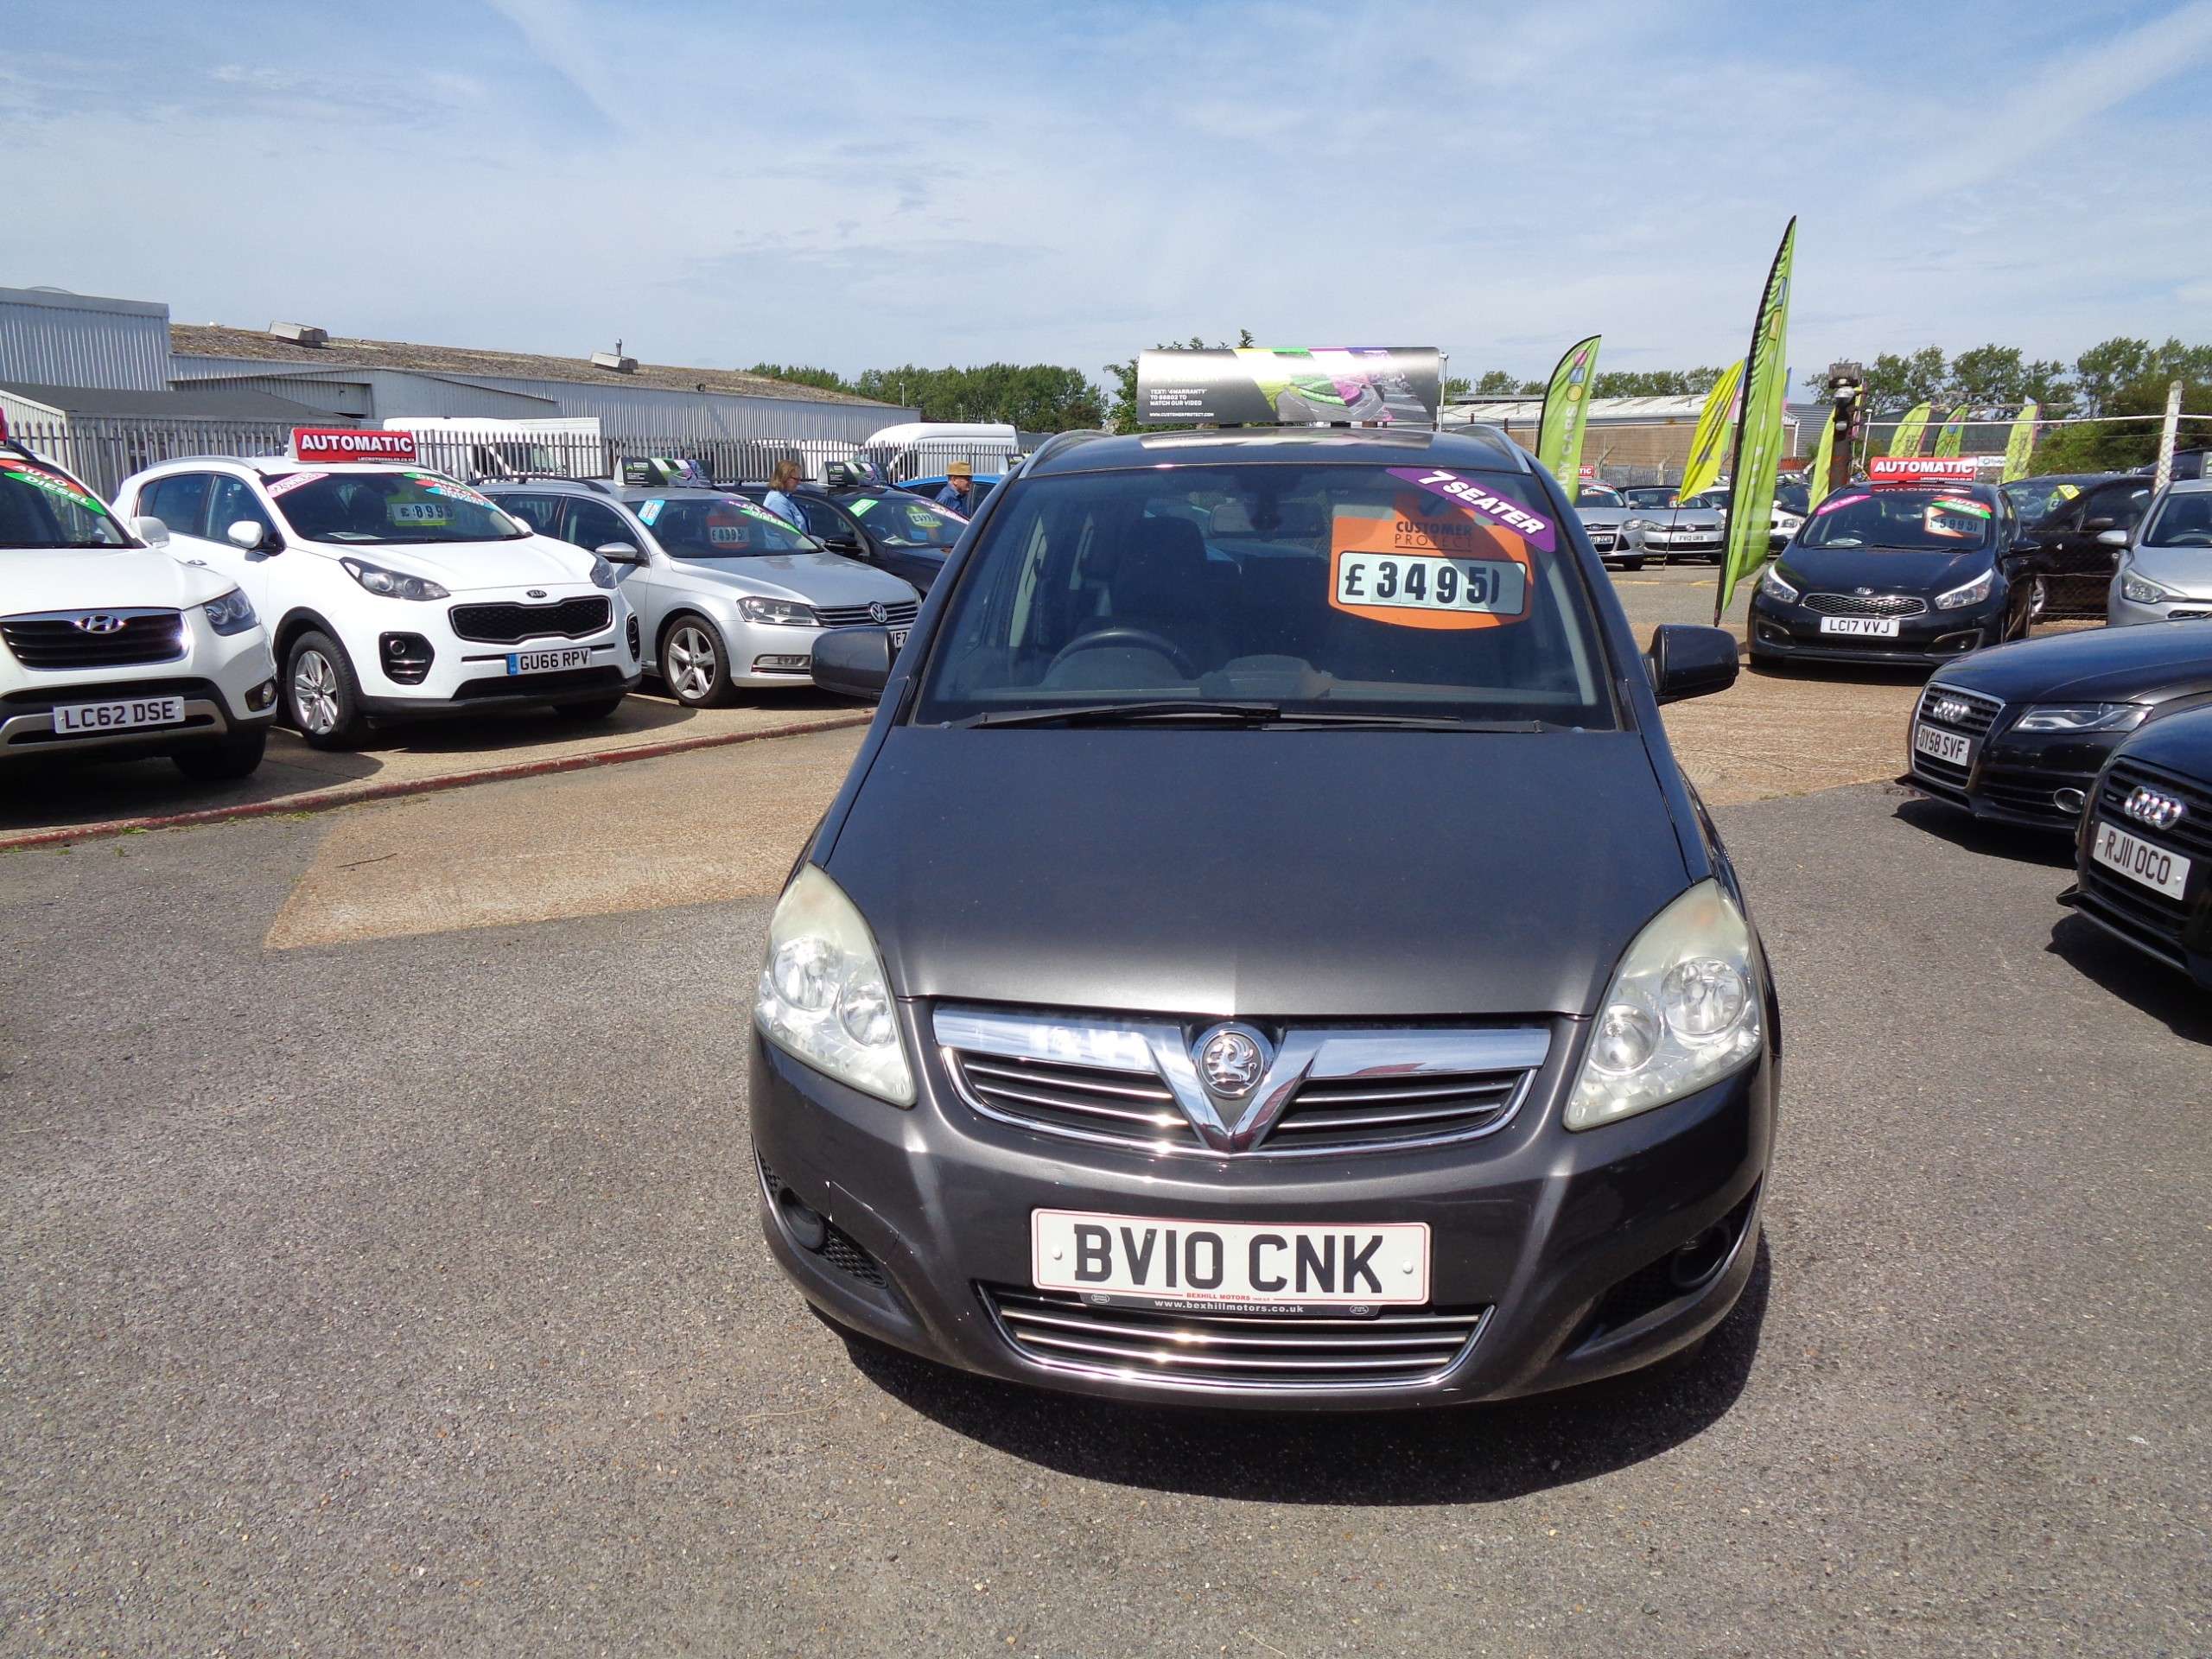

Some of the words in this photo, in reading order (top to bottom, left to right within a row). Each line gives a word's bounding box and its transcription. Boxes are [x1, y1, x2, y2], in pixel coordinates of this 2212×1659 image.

[1562, 405, 1578, 456] CARS
[301, 434, 413, 453] AUTOMATIC
[14, 466, 68, 486] AUTO
[1873, 461, 1974, 474] AUTOMATIC
[24, 475, 90, 505] DIESEL
[1418, 470, 1457, 485] 7
[1442, 481, 1546, 535] SEATER
[1948, 498, 1980, 508] AUTO
[1395, 521, 1473, 536] CUSTOMER
[1395, 534, 1472, 547] PROTECT
[1829, 617, 1859, 632] LC17
[1863, 621, 1890, 633] VVJ
[519, 653, 559, 671] GU66
[563, 651, 588, 667] RPV
[64, 705, 126, 729] LC62
[132, 700, 175, 722] DSE
[1942, 736, 1966, 760] SVF
[2104, 830, 2134, 868] RJ11
[2134, 845, 2171, 886] OCO
[1073, 1222, 1224, 1291] BV10
[1248, 1233, 1383, 1294] CNK
[1154, 1300, 1304, 1313] www.bexhillmotors.co.uk
[1219, 1293, 1250, 1301] MOTORS
